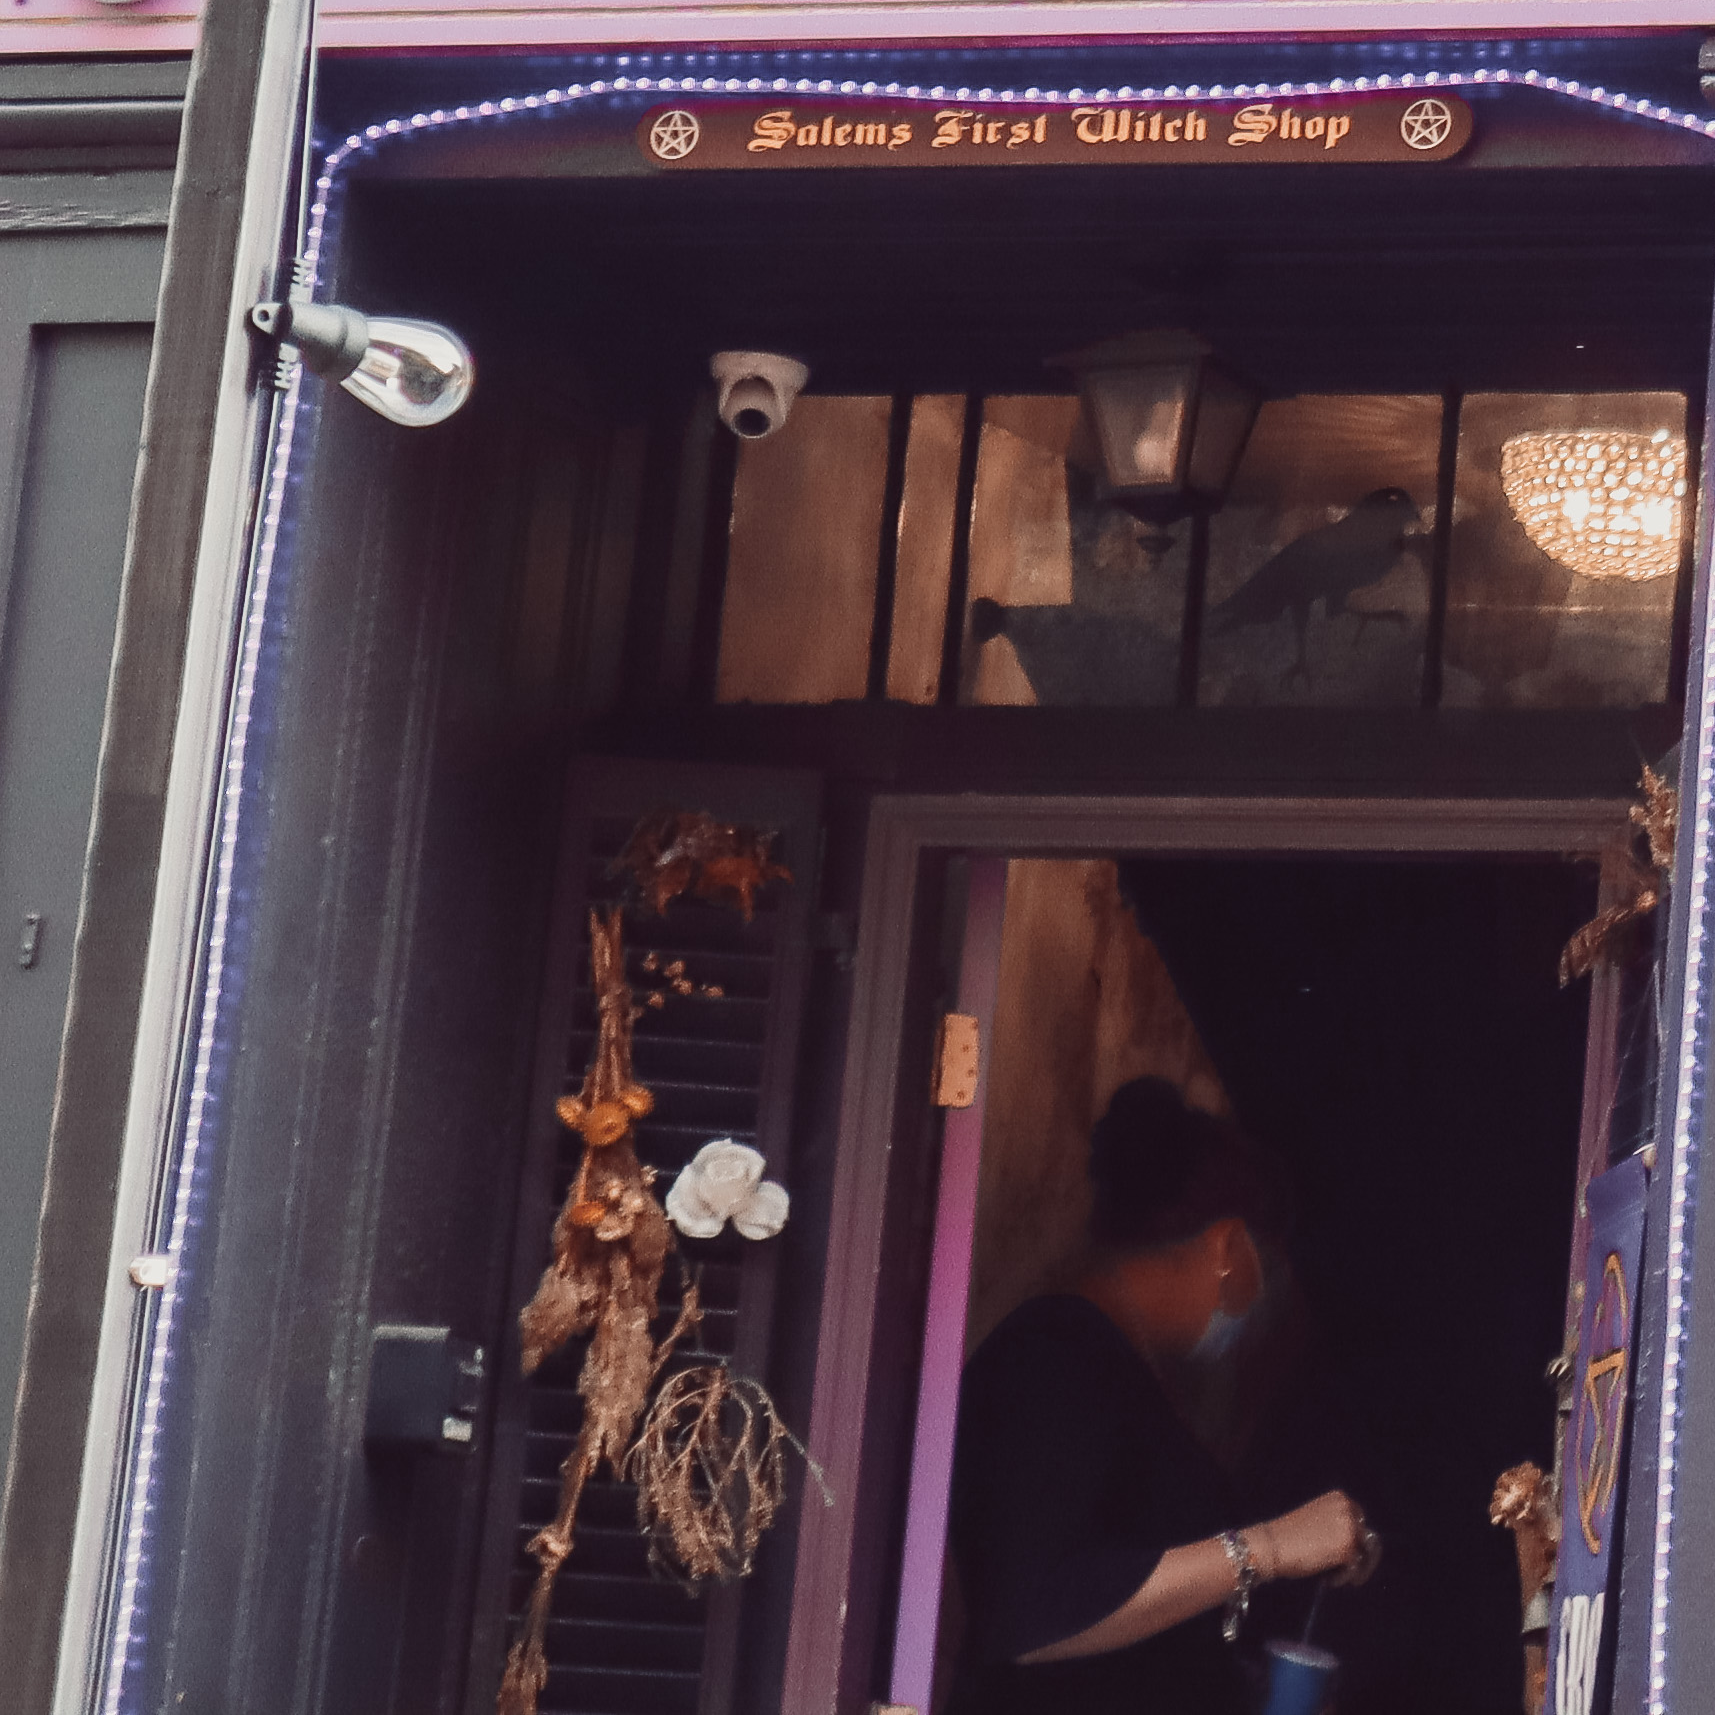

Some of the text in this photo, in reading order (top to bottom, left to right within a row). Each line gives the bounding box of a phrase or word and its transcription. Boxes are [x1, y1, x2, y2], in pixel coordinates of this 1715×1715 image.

[747, 103, 1352, 152] Salems First Witch Shop
